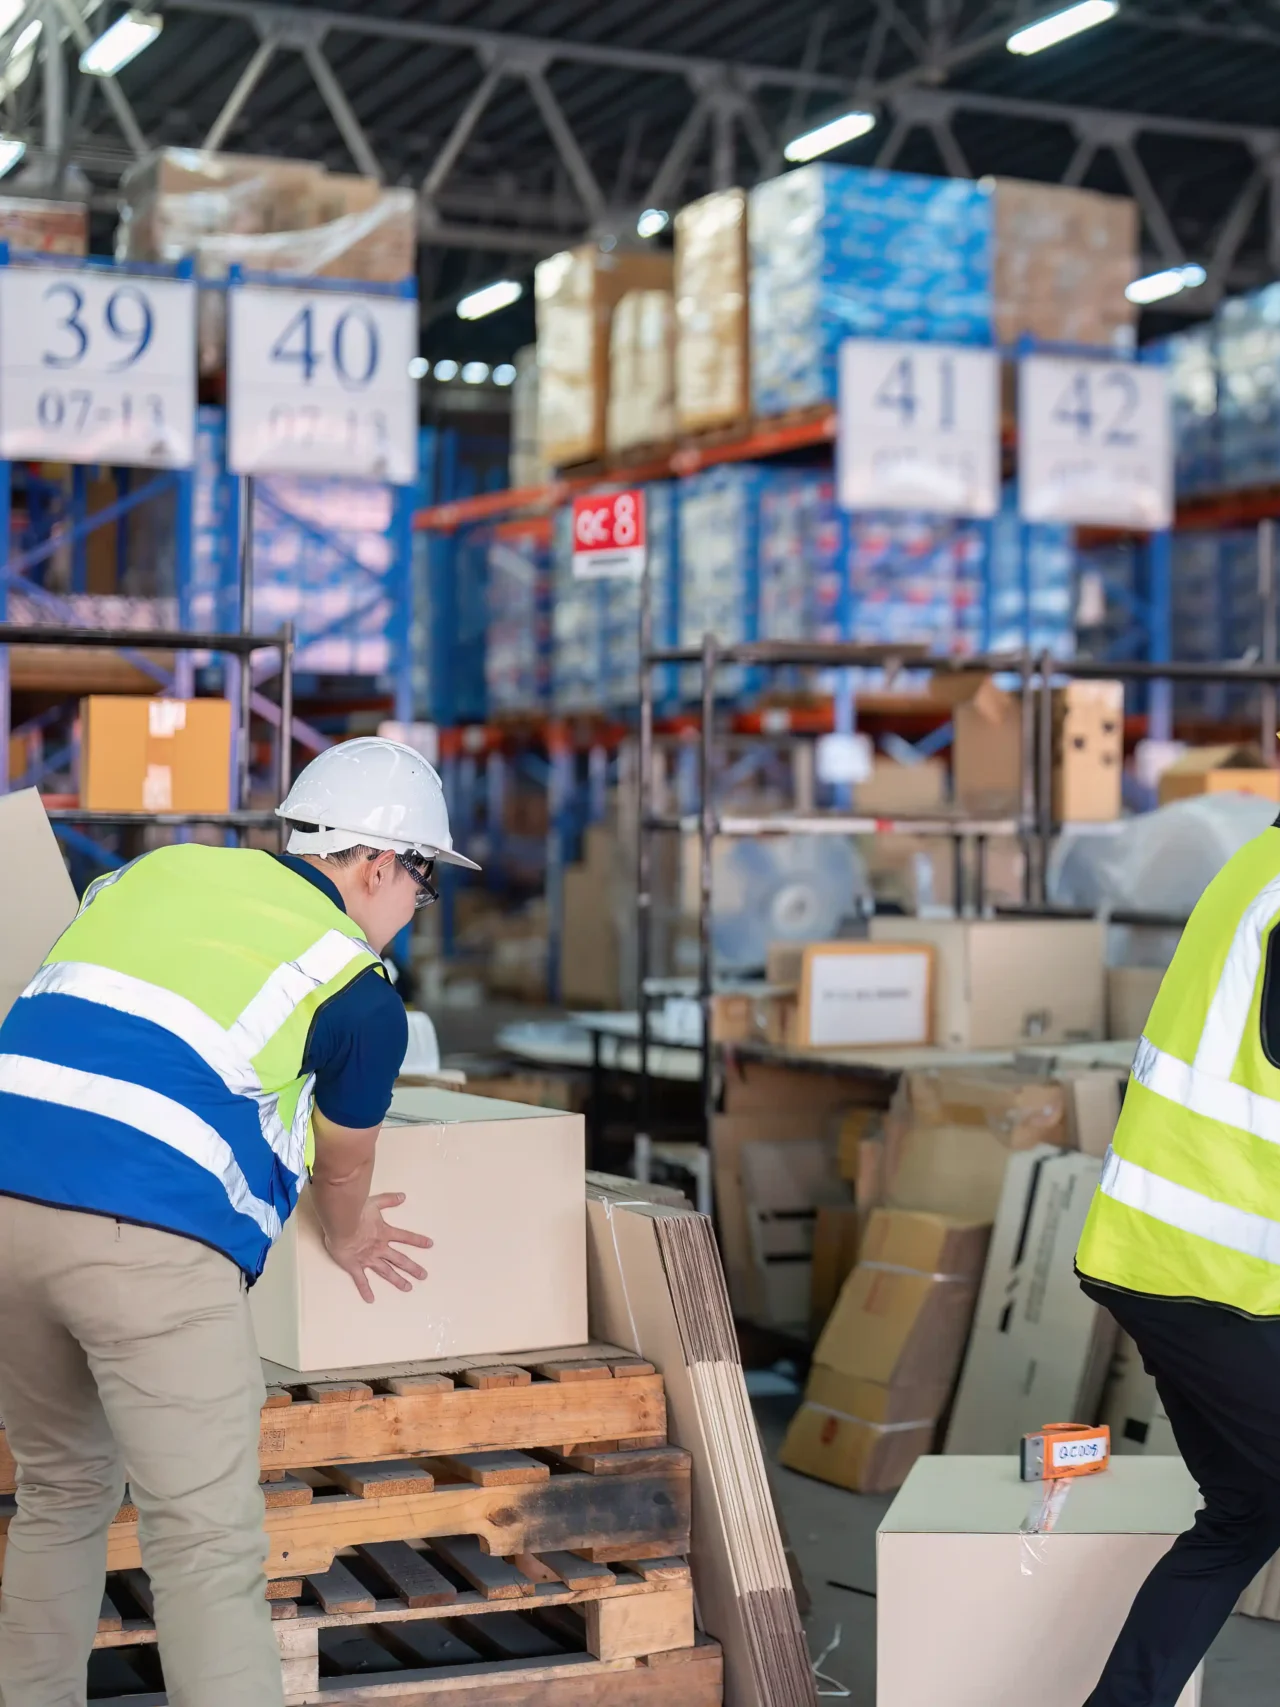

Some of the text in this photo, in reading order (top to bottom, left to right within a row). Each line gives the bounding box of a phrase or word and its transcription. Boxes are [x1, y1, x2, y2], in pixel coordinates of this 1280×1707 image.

[42, 281, 156, 373] 39
[271, 303, 380, 393] 40
[873, 354, 956, 432] 41
[1052, 368, 1139, 445] 42
[612, 493, 637, 545] 8
